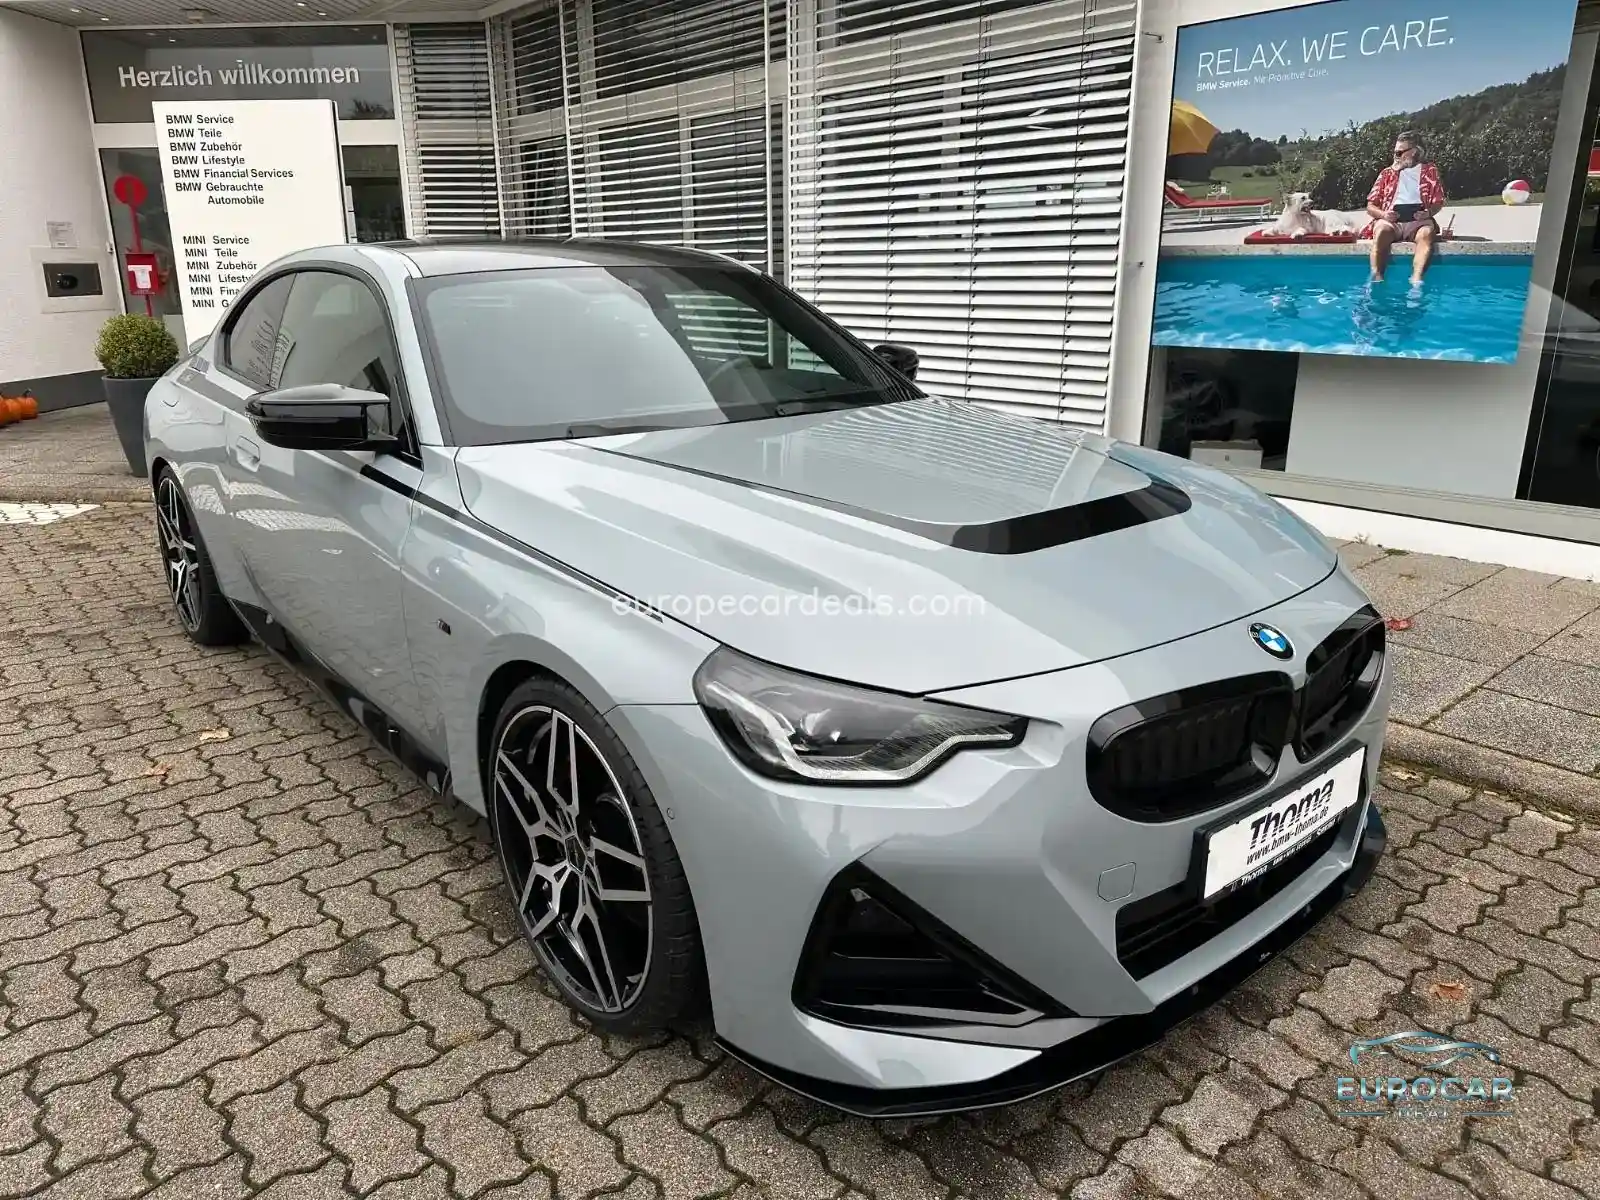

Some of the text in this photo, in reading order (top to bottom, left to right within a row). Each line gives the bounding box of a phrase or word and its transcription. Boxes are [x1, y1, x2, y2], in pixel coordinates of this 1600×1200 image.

[1197, 16, 1455, 78] RELAX. WE CARE.
[118, 60, 360, 88] Herzlich willkommen
[1196, 81, 1218, 92] BMW
[165, 113, 235, 124] BMW Service
[168, 127, 223, 138] BMW Teile
[170, 141, 243, 152] BMW Zubehör
[172, 155, 246, 167] BMW Lifestyle
[173, 168, 294, 179] BMW Financial Services
[175, 182, 264, 192] BMW Gebrauchte
[207, 195, 265, 205] Automobile
[183, 235, 250, 245] MINI Service
[185, 248, 238, 258] MINI Teile
[187, 261, 257, 271] MINI Zubehör
[188, 274, 211, 284] MINI
[190, 287, 213, 296] MINI
[192, 300, 215, 309] MINI
[1250, 778, 1334, 849] Thoma
